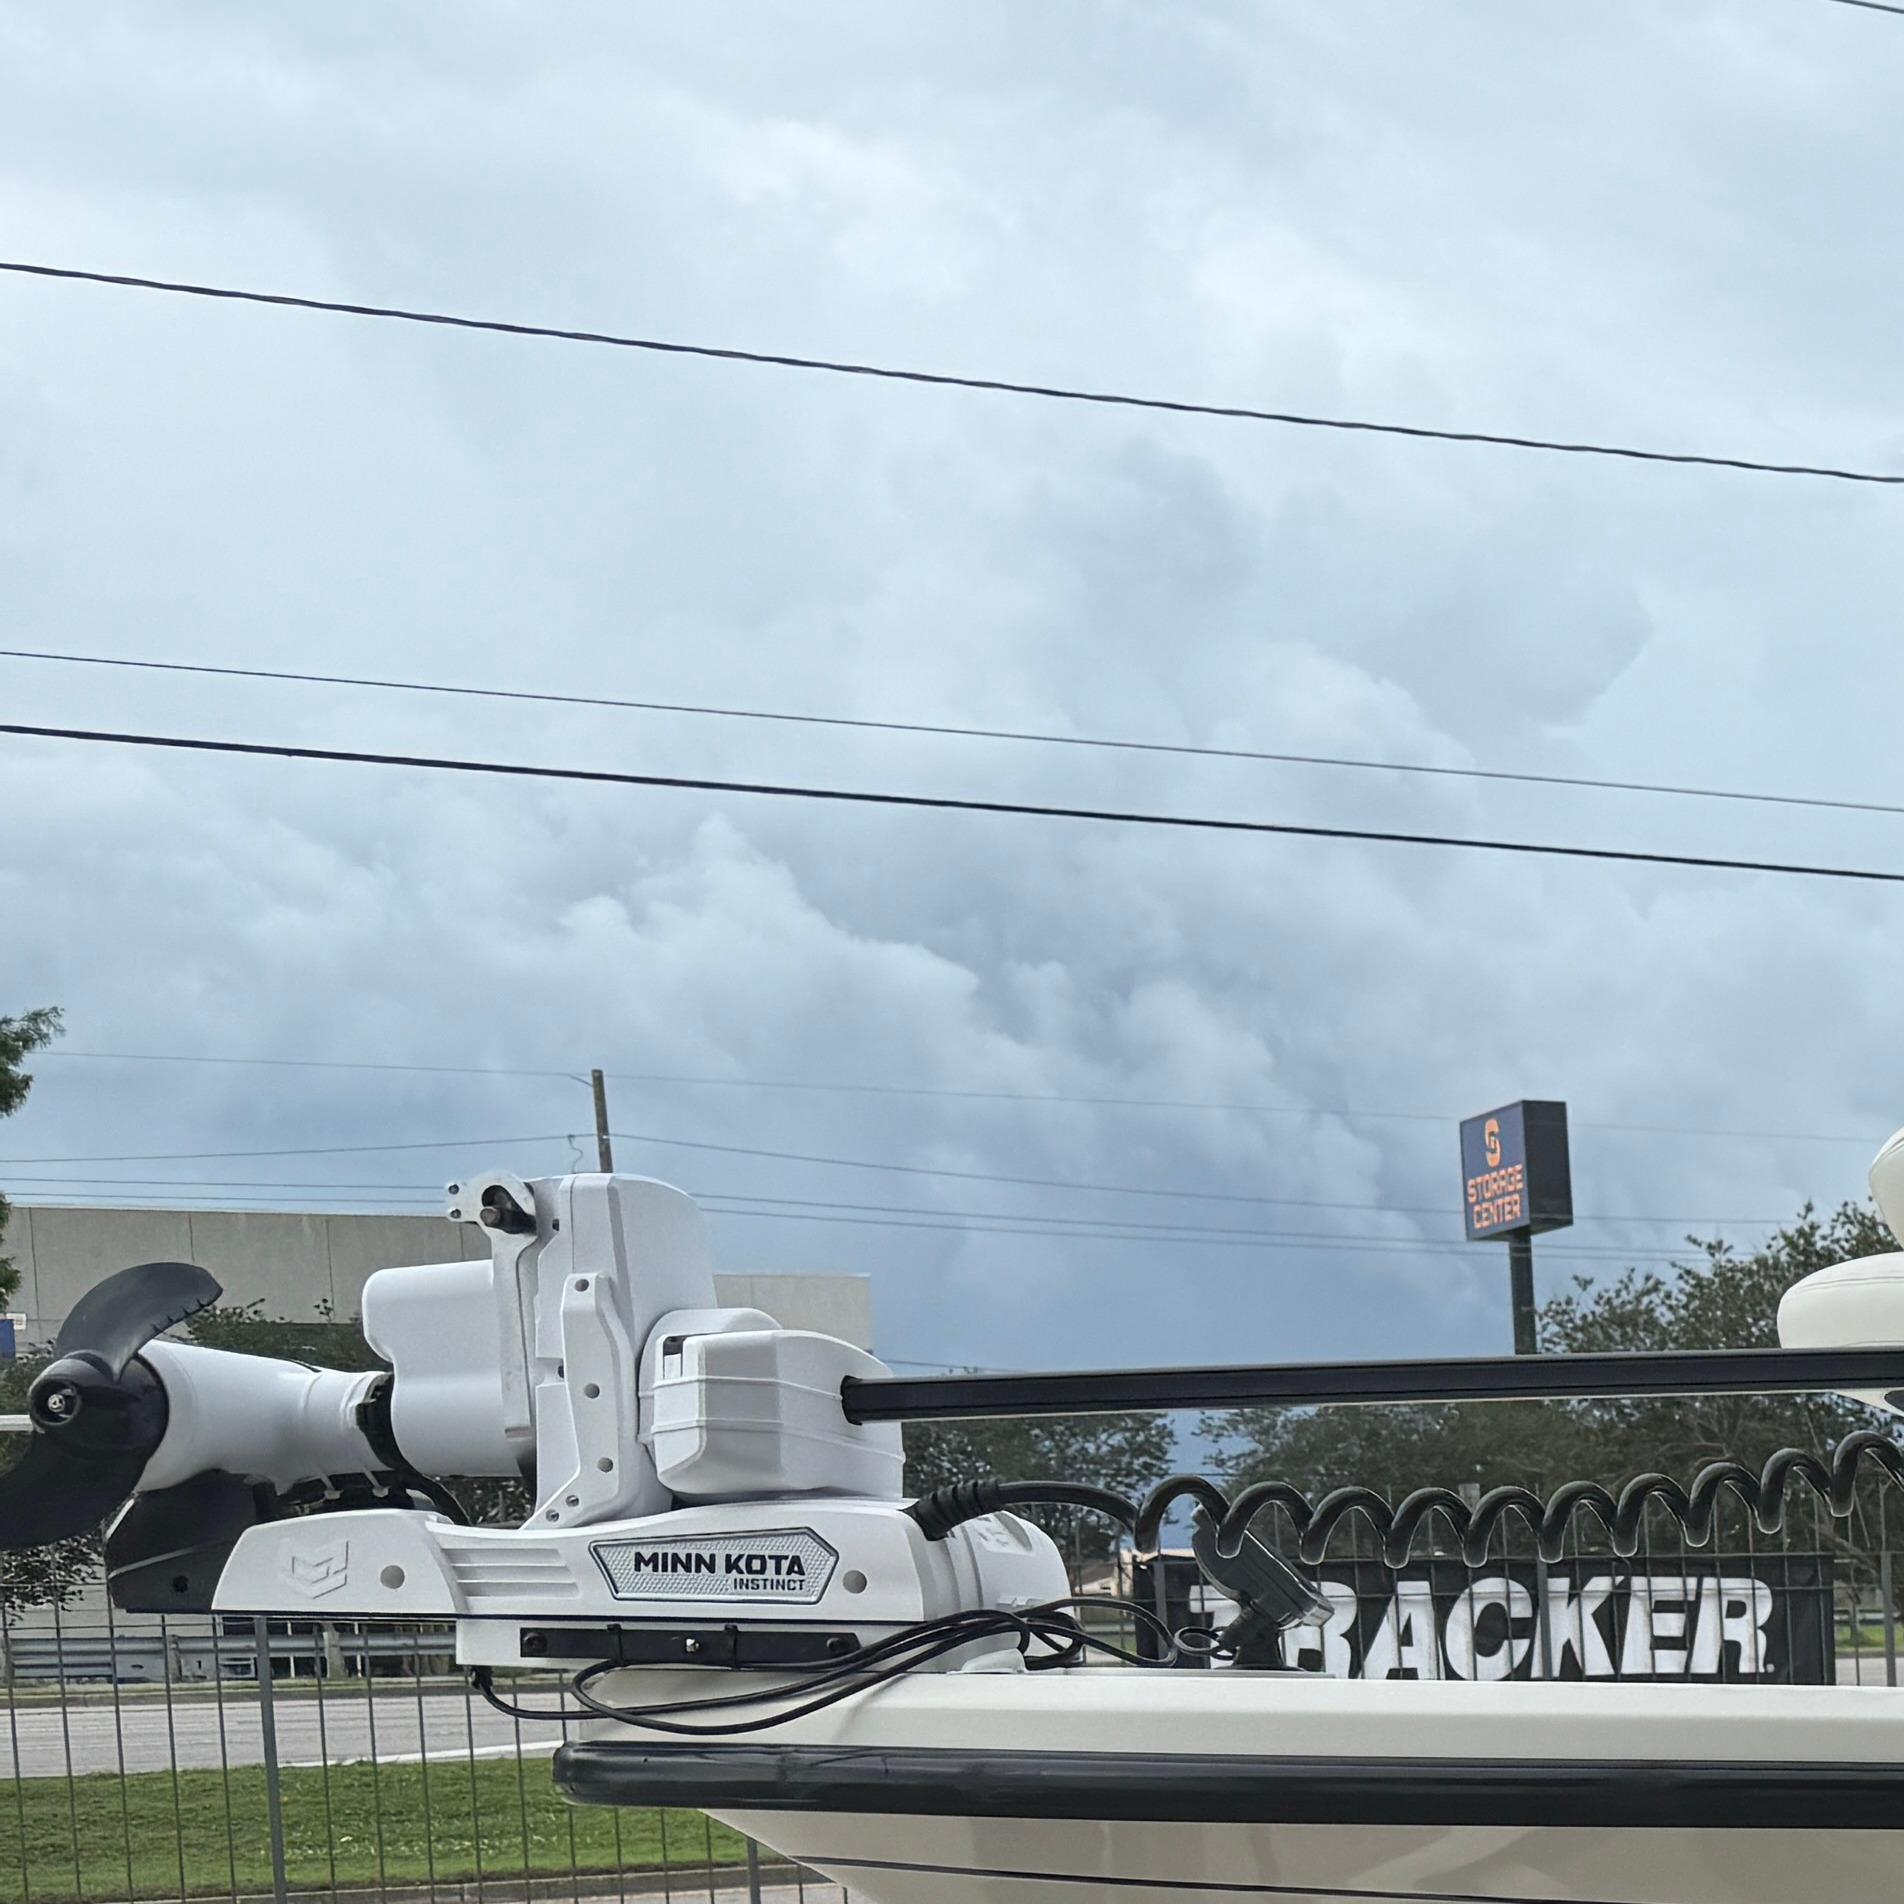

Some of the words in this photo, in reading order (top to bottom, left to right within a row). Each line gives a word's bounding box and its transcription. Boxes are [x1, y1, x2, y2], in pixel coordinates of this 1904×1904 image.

[1467, 1163, 1523, 1204] STORAGE
[1473, 1193, 1521, 1230] CENTER
[634, 1551, 716, 1574] MINN
[725, 1553, 806, 1576] KOTA
[733, 1578, 805, 1591] INSTINCT
